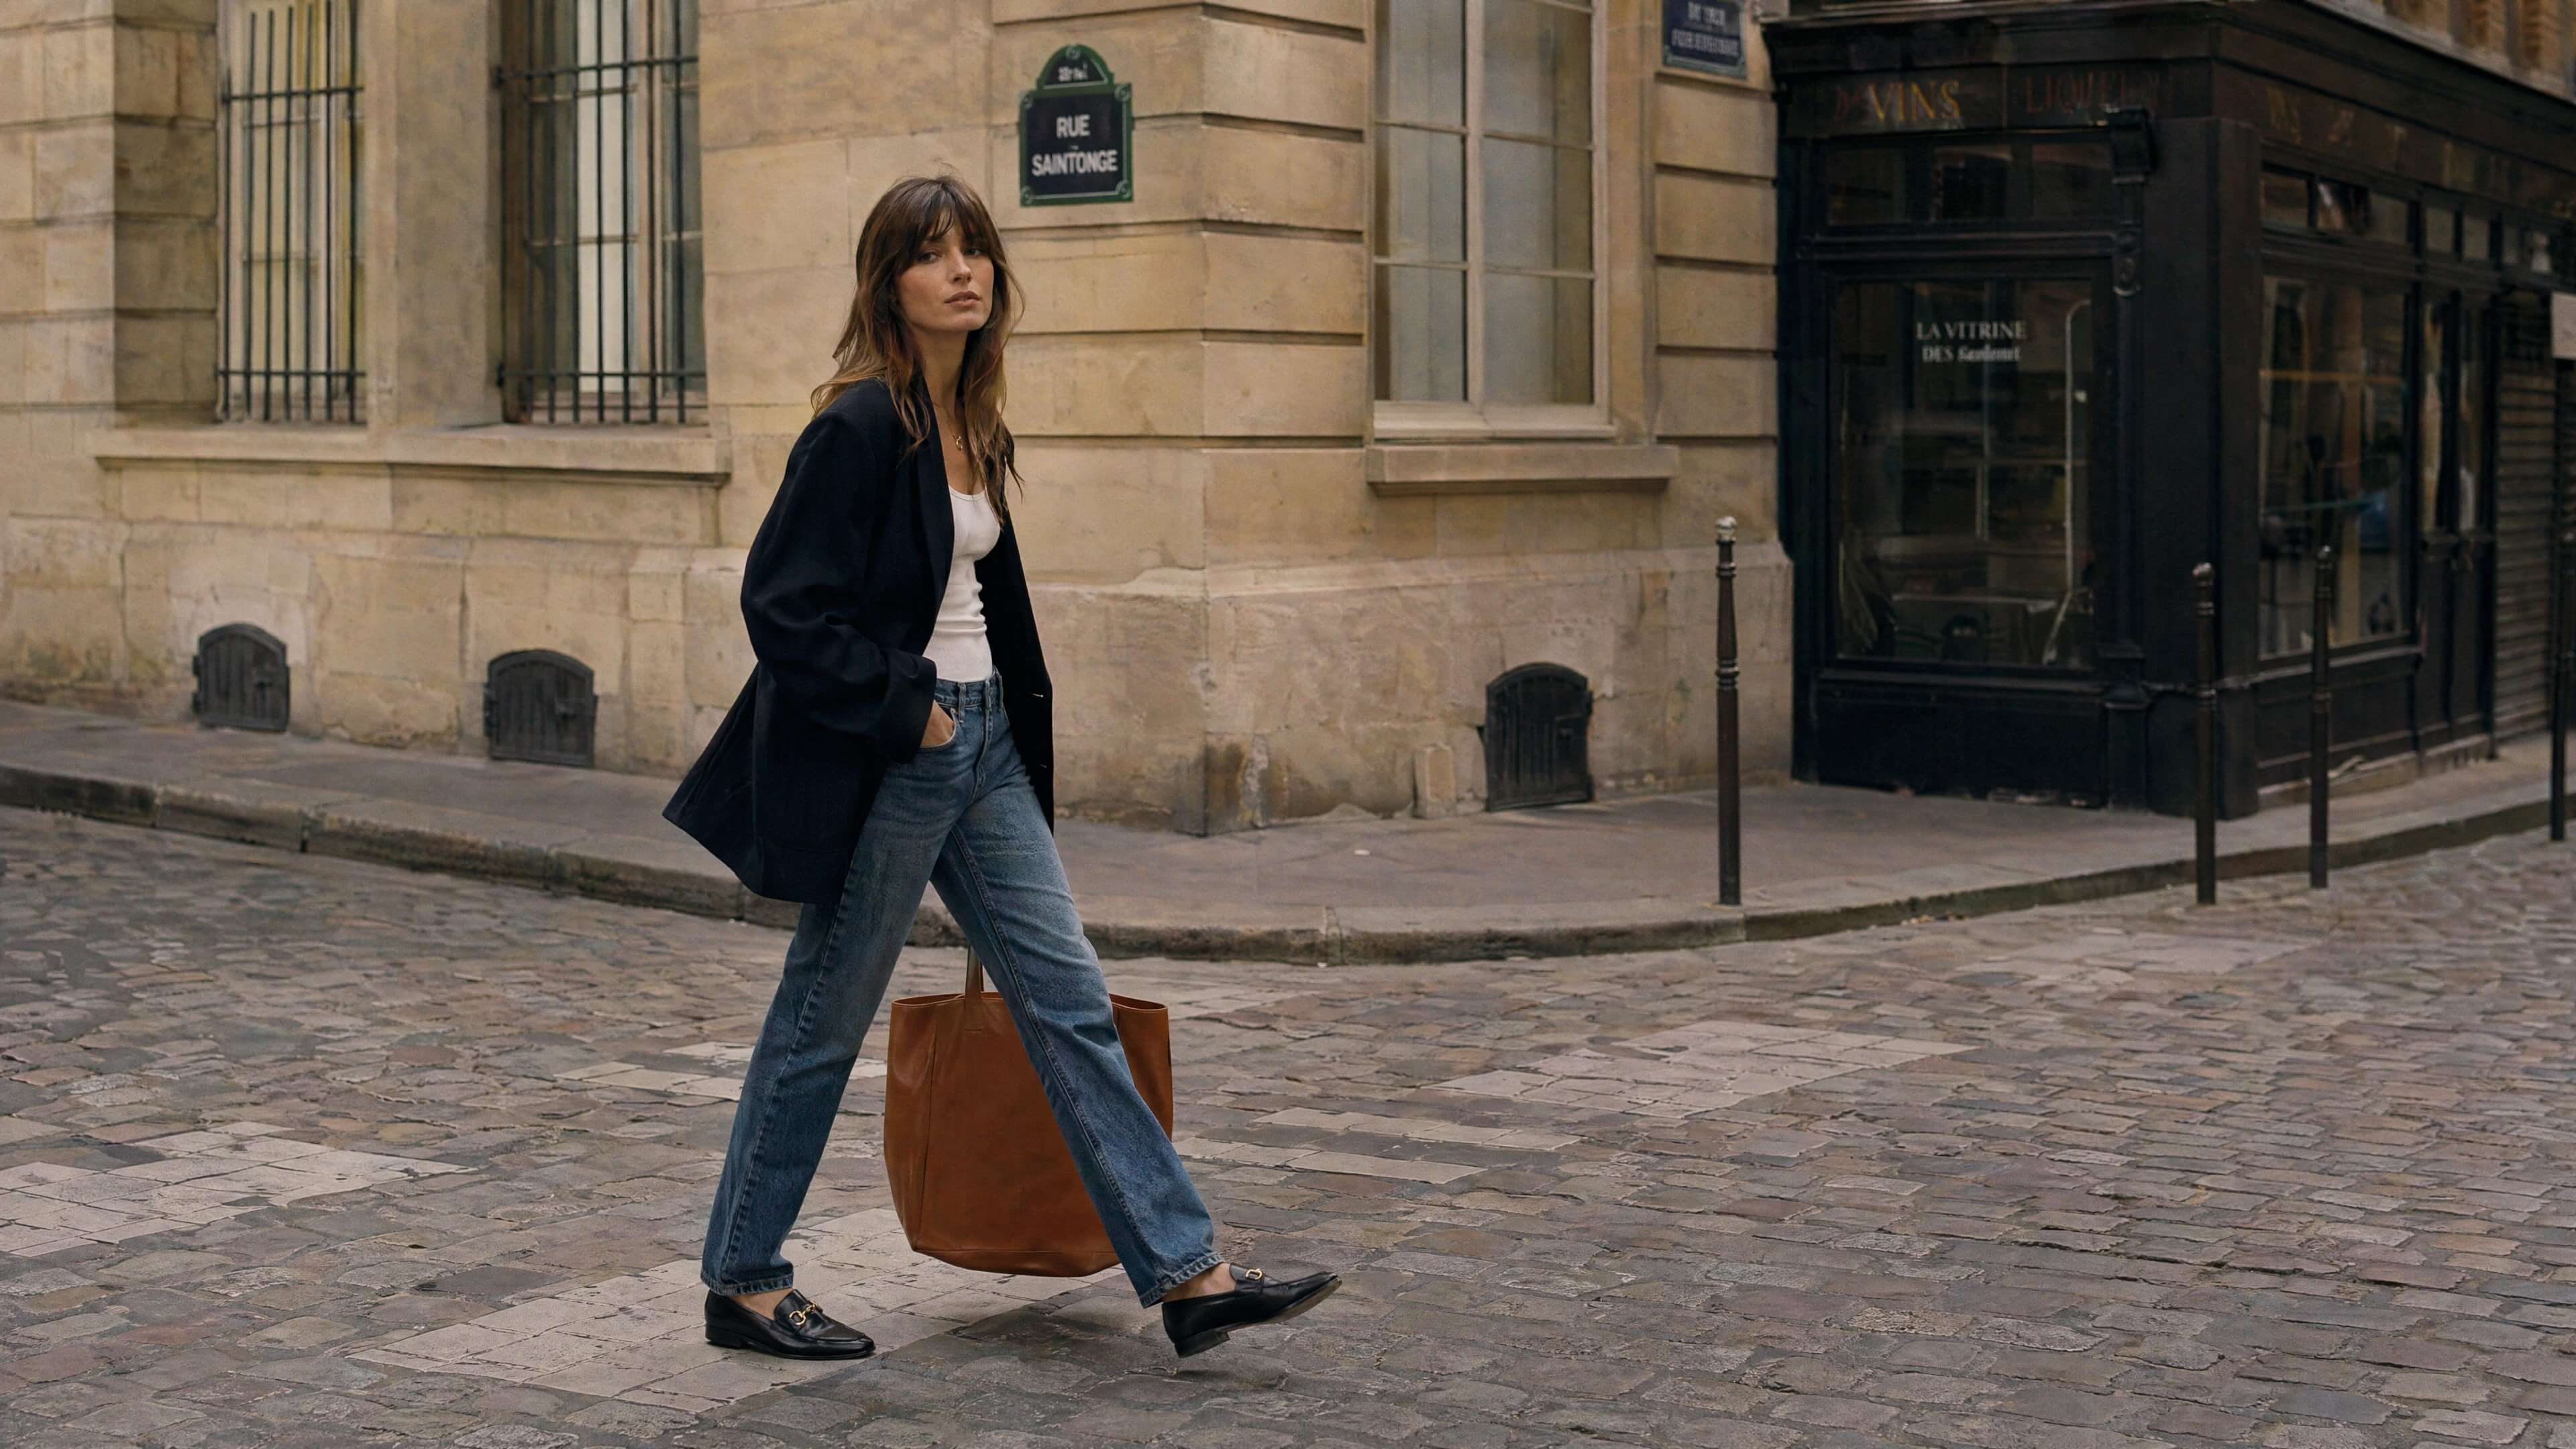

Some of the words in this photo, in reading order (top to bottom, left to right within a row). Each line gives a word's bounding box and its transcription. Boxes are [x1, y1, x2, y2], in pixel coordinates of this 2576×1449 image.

[1867, 78, 1961, 123] VINS
[1056, 114, 1091, 138] RUE
[1031, 149, 1119, 177] SAINTONGE
[1915, 321, 1942, 340] LA
[1944, 321, 2028, 340] VITRINE
[1921, 344, 1954, 363] DES
